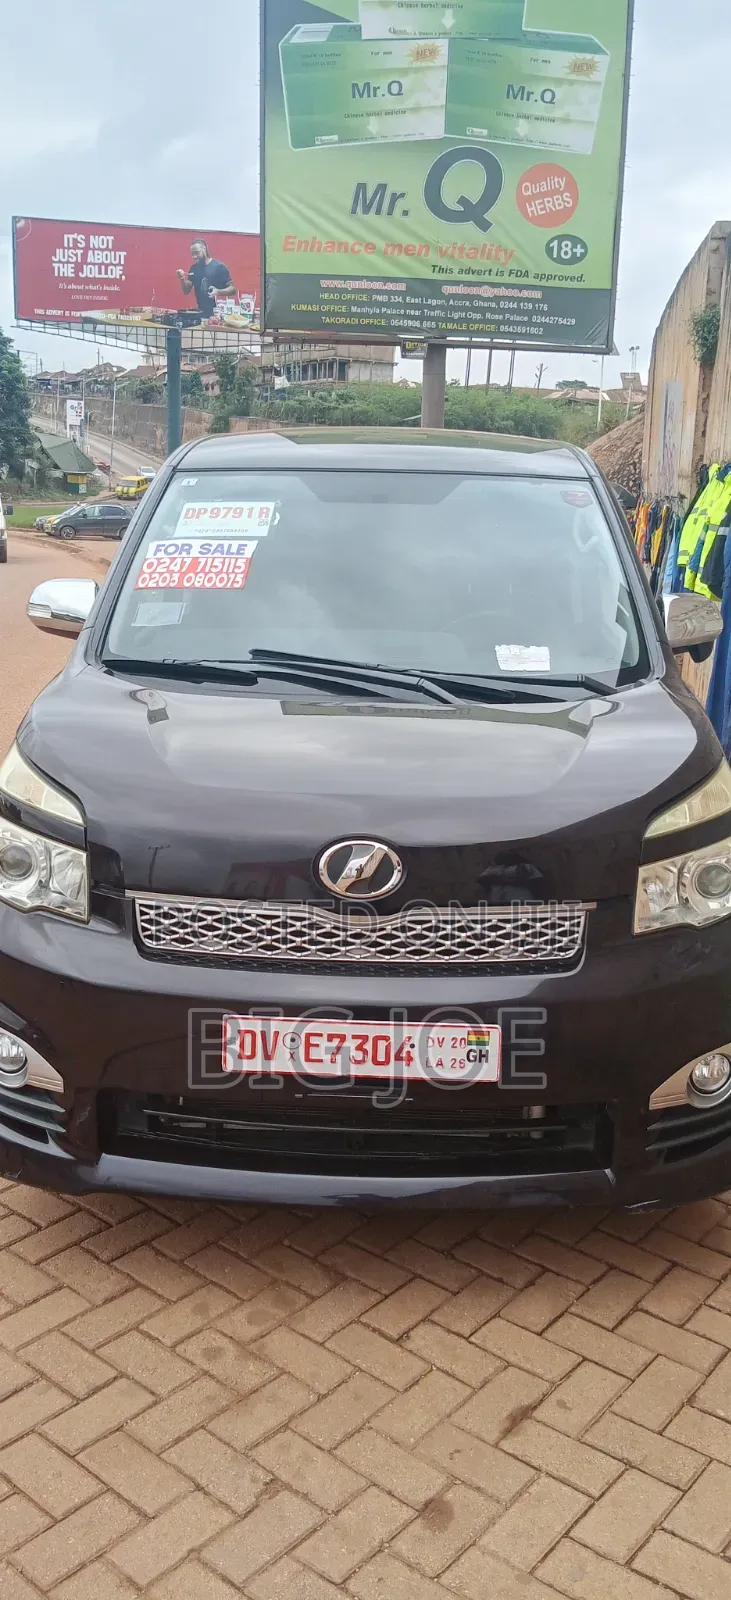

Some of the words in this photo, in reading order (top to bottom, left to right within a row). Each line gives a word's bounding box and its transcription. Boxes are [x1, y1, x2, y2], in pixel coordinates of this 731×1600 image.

[416, 49, 437, 60] NEW
[573, 62, 594, 73] NEW
[351, 80, 404, 99] Mr.Q
[505, 83, 556, 105] Mr.Q
[350, 182, 410, 217] Mr.
[423, 145, 504, 234] Q
[521, 176, 567, 196] Quality
[526, 192, 573, 218] HERBS
[64, 232, 86, 248] IT'S
[89, 235, 114, 249] NOT
[52, 248, 84, 263] JUST
[87, 250, 127, 265] ABOUT
[281, 235, 377, 256] Enhance
[382, 242, 431, 258] men
[437, 241, 516, 267] vitality
[549, 239, 585, 260] 18+
[52, 263, 75, 277] THE
[79, 264, 126, 281] JOLLOF,
[431, 264, 454, 275] This
[457, 266, 493, 277] advert
[495, 269, 505, 278] is
[507, 269, 530, 279] FDA
[532, 271, 586, 283] approved.
[58, 282, 67, 290] It's
[319, 292, 340, 300] HEAD
[341, 294, 371, 302] OFFICE:
[406, 297, 422, 305] East
[423, 298, 448, 307] Lagon,
[449, 299, 472, 308] Accra,
[473, 300, 498, 309] Ghana,
[500, 301, 518, 309] 0244
[520, 302, 533, 310] 139
[535, 303, 548, 312] 176
[46, 309, 64, 317] ADVERT
[290, 303, 320, 312] KUMASI
[321, 304, 350, 313] OFFICE:
[423, 309, 446, 318] Traffic
[447, 310, 466, 319] Light
[467, 312, 484, 320] Opp.
[505, 314, 529, 322] Palace
[321, 317, 359, 325] TAKORADI
[360, 318, 389, 327] OFFICE:
[438, 322, 468, 330] TAMALE
[469, 323, 498, 332] OFFICE:
[184, 507, 208, 519] DP
[258, 506, 270, 519] R
[153, 543, 193, 556] FOR
[197, 543, 248, 556] SALE
[142, 557, 192, 573] 0247
[195, 558, 247, 573] 715115
[138, 573, 179, 588] 0203
[183, 573, 243, 588] 080075
[237, 1029, 280, 1060] DV
[304, 1032, 414, 1067] E7304
[451, 1037, 467, 1049] 20
[466, 1048, 490, 1064] GH
